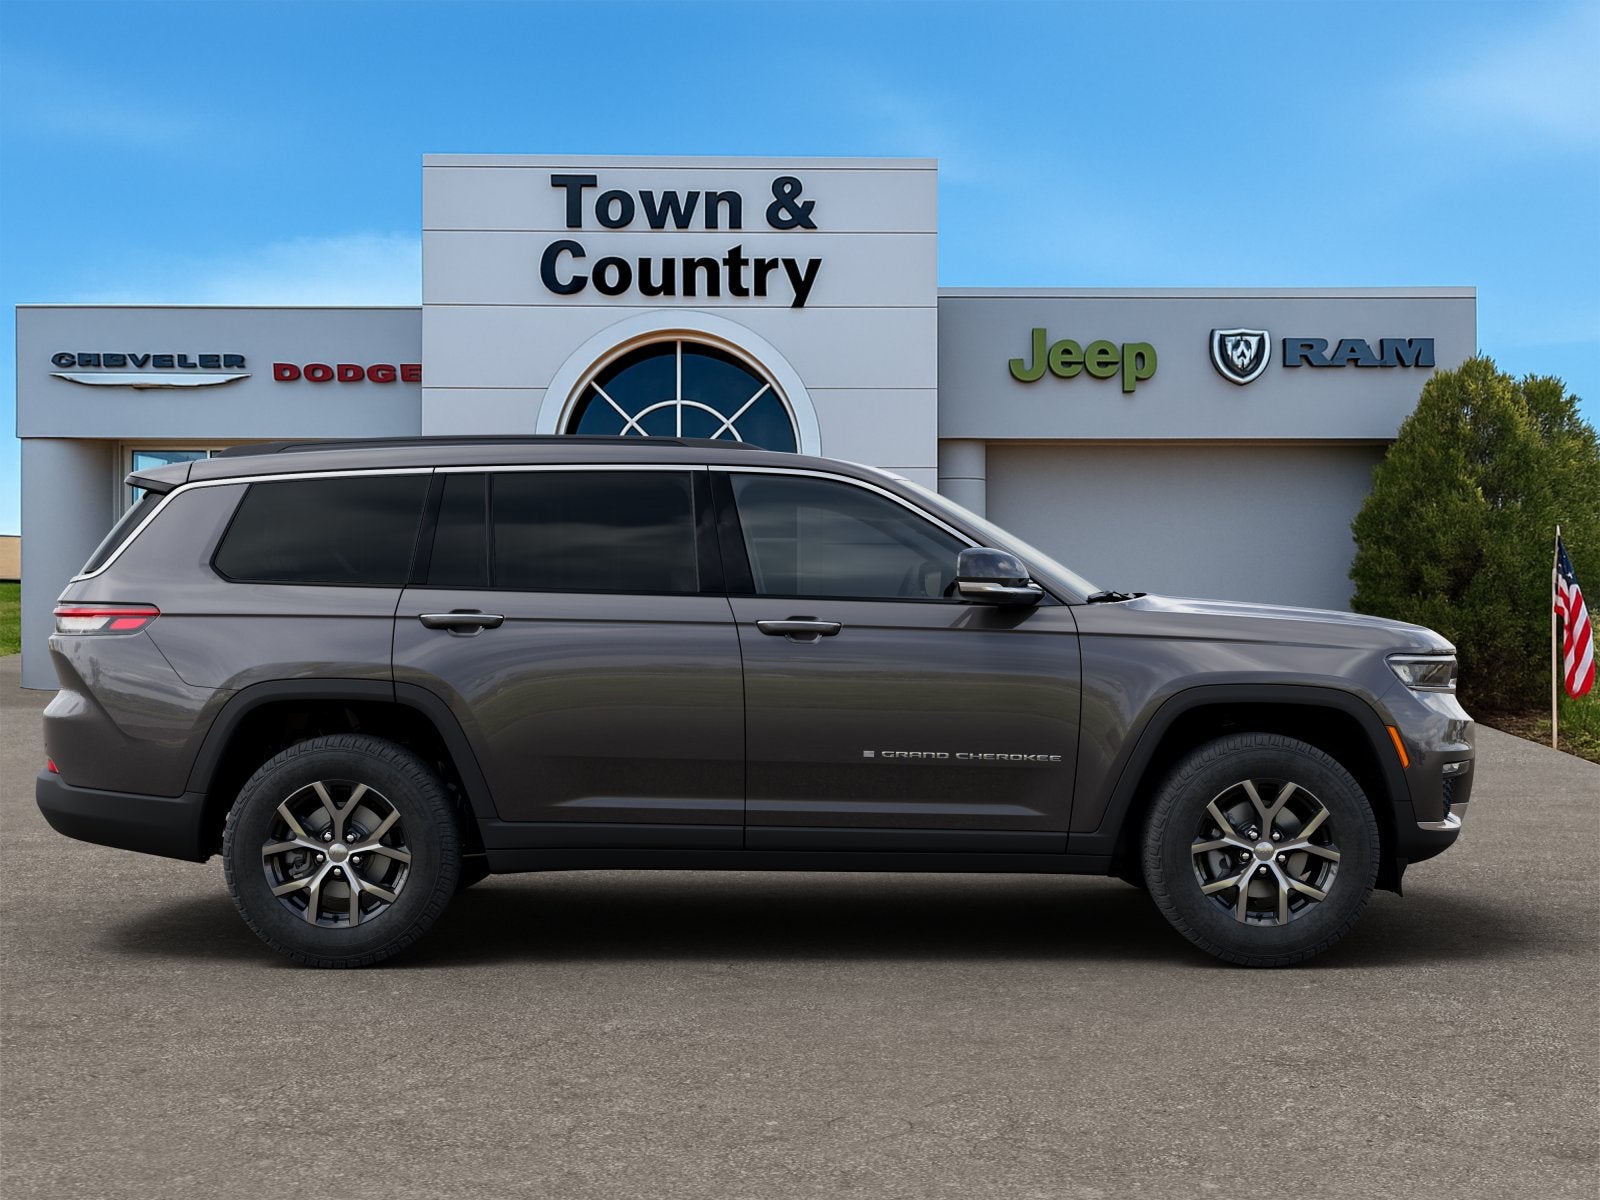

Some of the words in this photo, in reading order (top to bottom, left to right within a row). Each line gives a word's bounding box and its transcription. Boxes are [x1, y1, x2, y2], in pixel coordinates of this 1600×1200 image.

[550, 174, 743, 230] Town
[765, 175, 818, 230] &
[540, 239, 822, 308] Country
[273, 362, 422, 384] DODGE
[1008, 327, 1157, 393] Jeep
[1282, 337, 1436, 369] RAM
[881, 750, 950, 760] GRAND
[955, 751, 1063, 762] CHEROKEE
